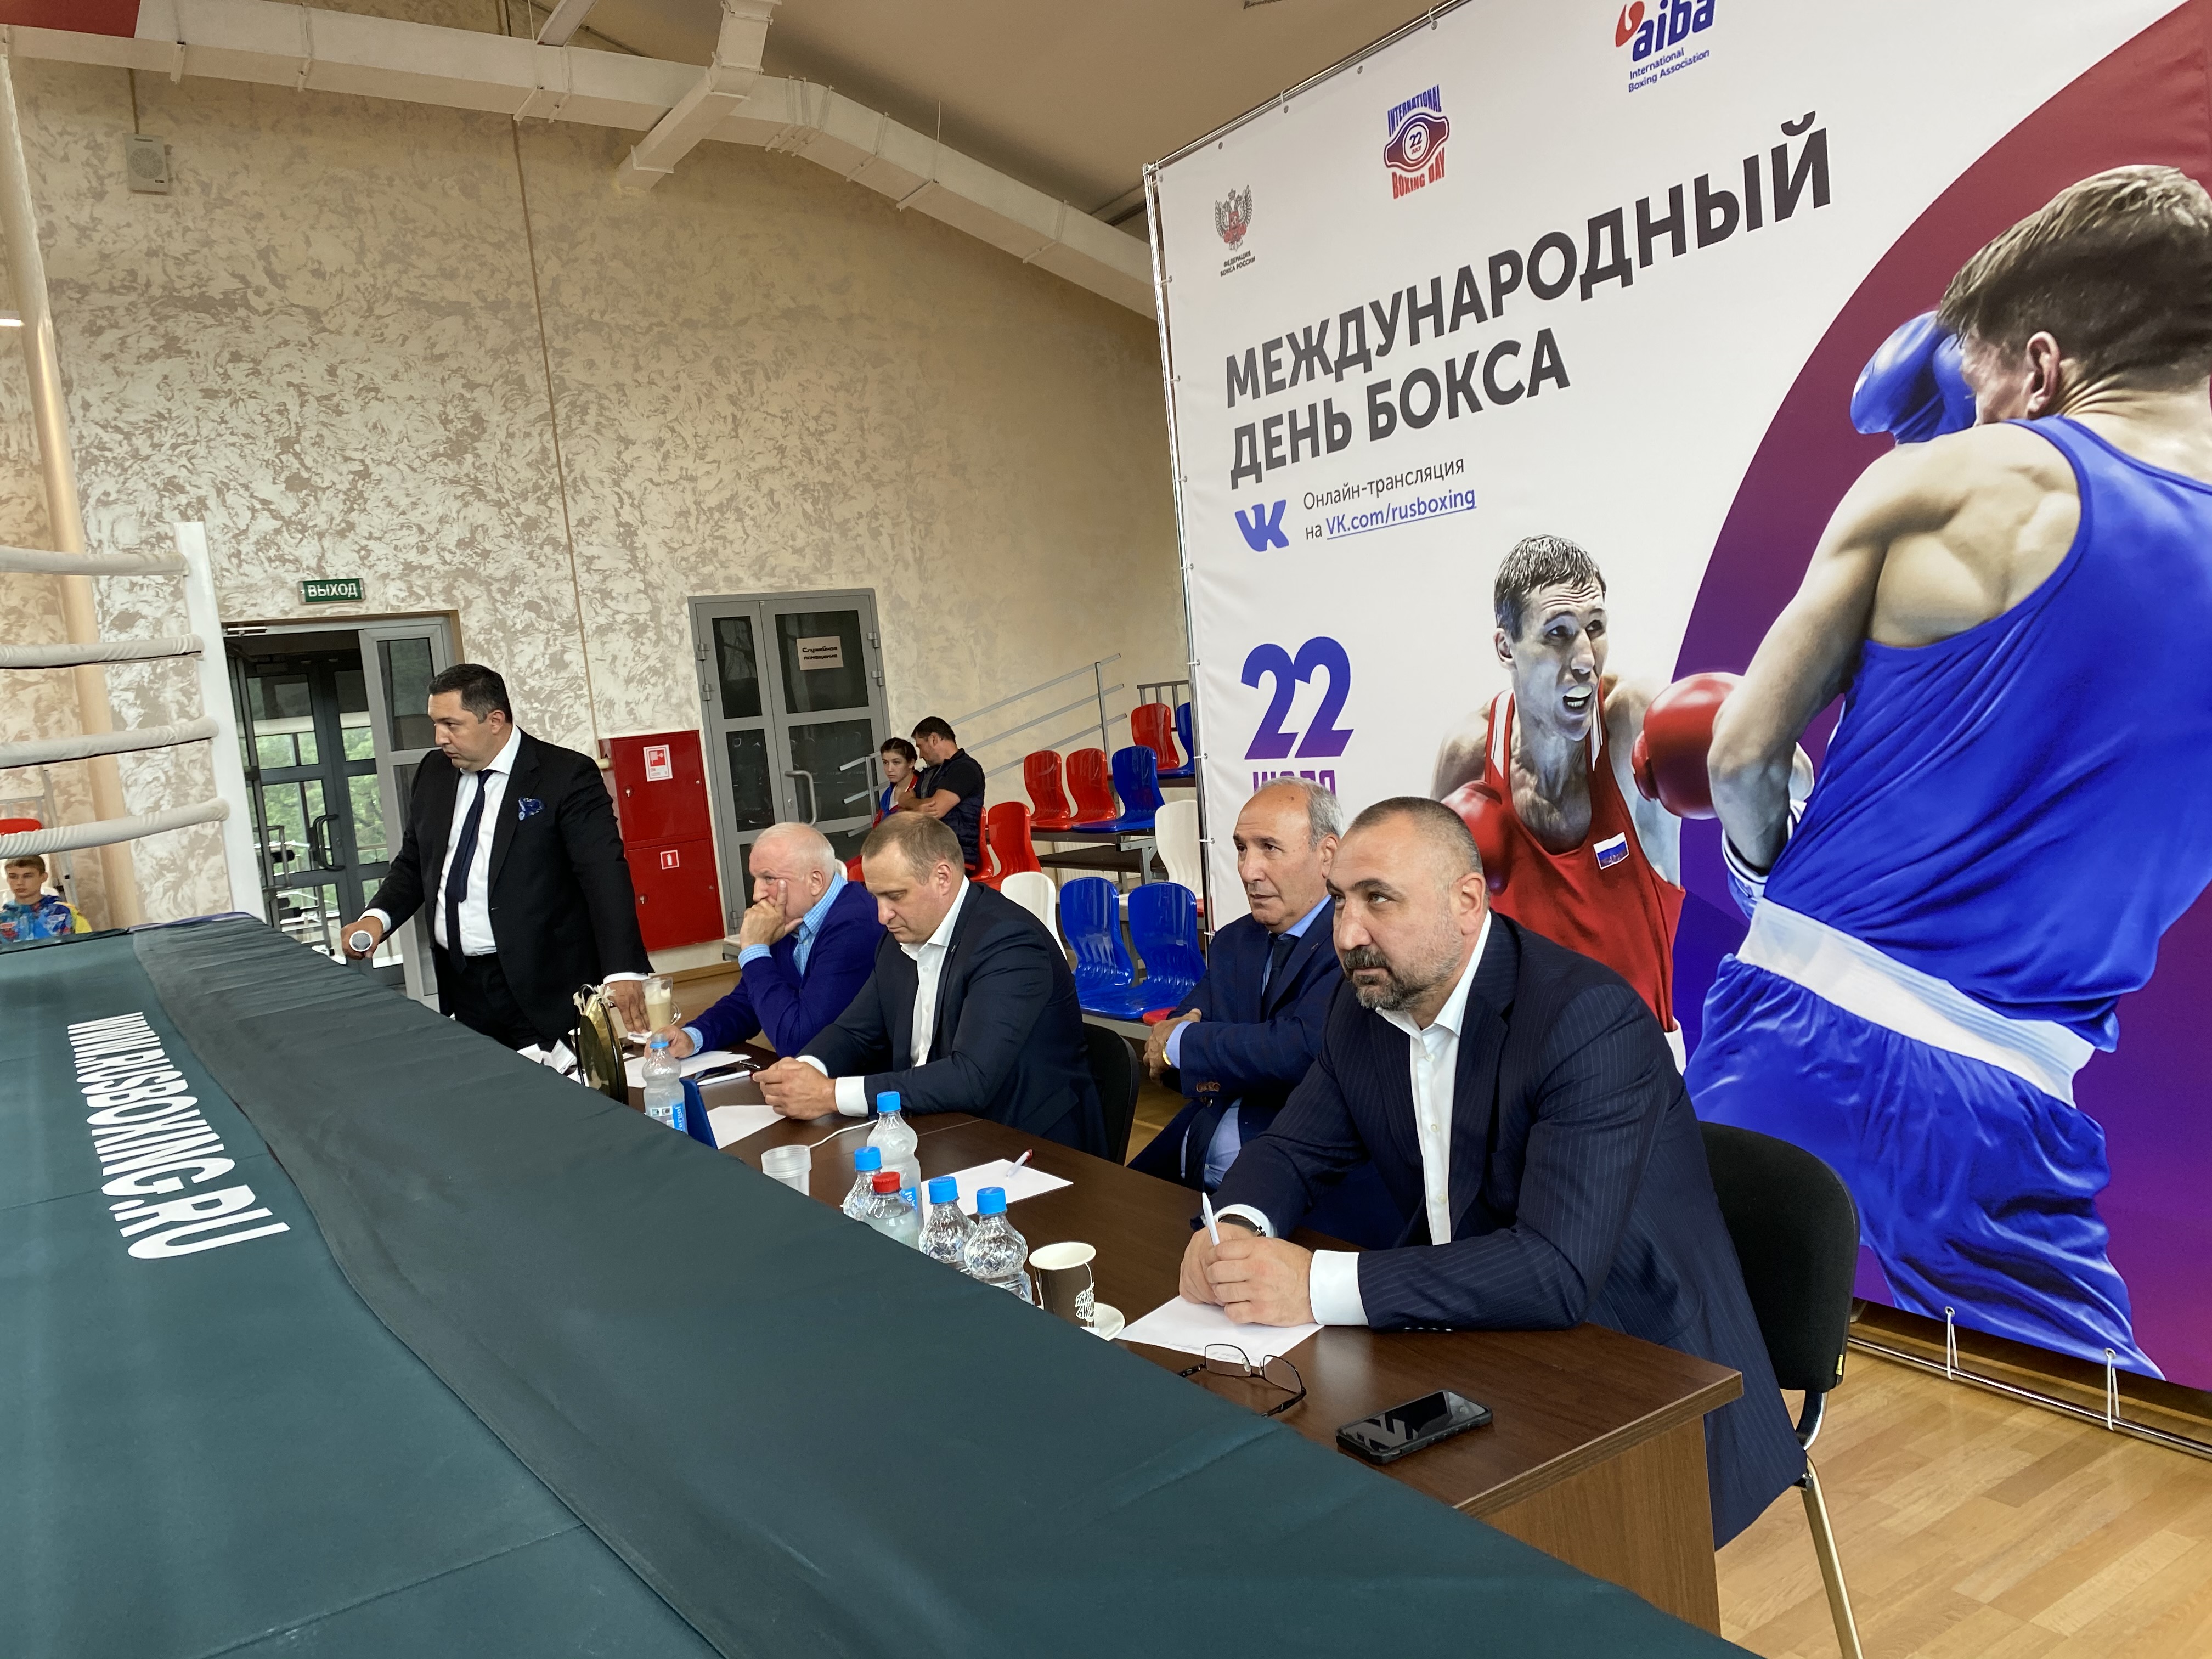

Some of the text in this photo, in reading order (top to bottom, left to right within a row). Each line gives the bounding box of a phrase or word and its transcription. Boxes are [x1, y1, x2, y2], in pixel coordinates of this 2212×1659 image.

[1633, 0, 1716, 62] aiba
[1628, 50, 1710, 93] Boxing Association
[1630, 47, 1684, 80] International
[1387, 84, 1442, 137] INTERNATIONAL
[1409, 131, 1423, 149] 22
[1411, 145, 1421, 155] JULY
[1392, 146, 1445, 200] BOXING DAY
[1226, 110, 1831, 408] МЕЖДУНАРОДНЫЙ
[1230, 327, 1571, 490] ДЕНЬ БОКСА
[1304, 458, 1464, 510] Онлайн-трансляция
[1305, 489, 1476, 540] на VK.com/rusboxing
[307, 583, 358, 597] ВЫХОД
[1240, 636, 1355, 760] 22
[67, 1011, 291, 1259] WWW.RUSBOXING.RU
